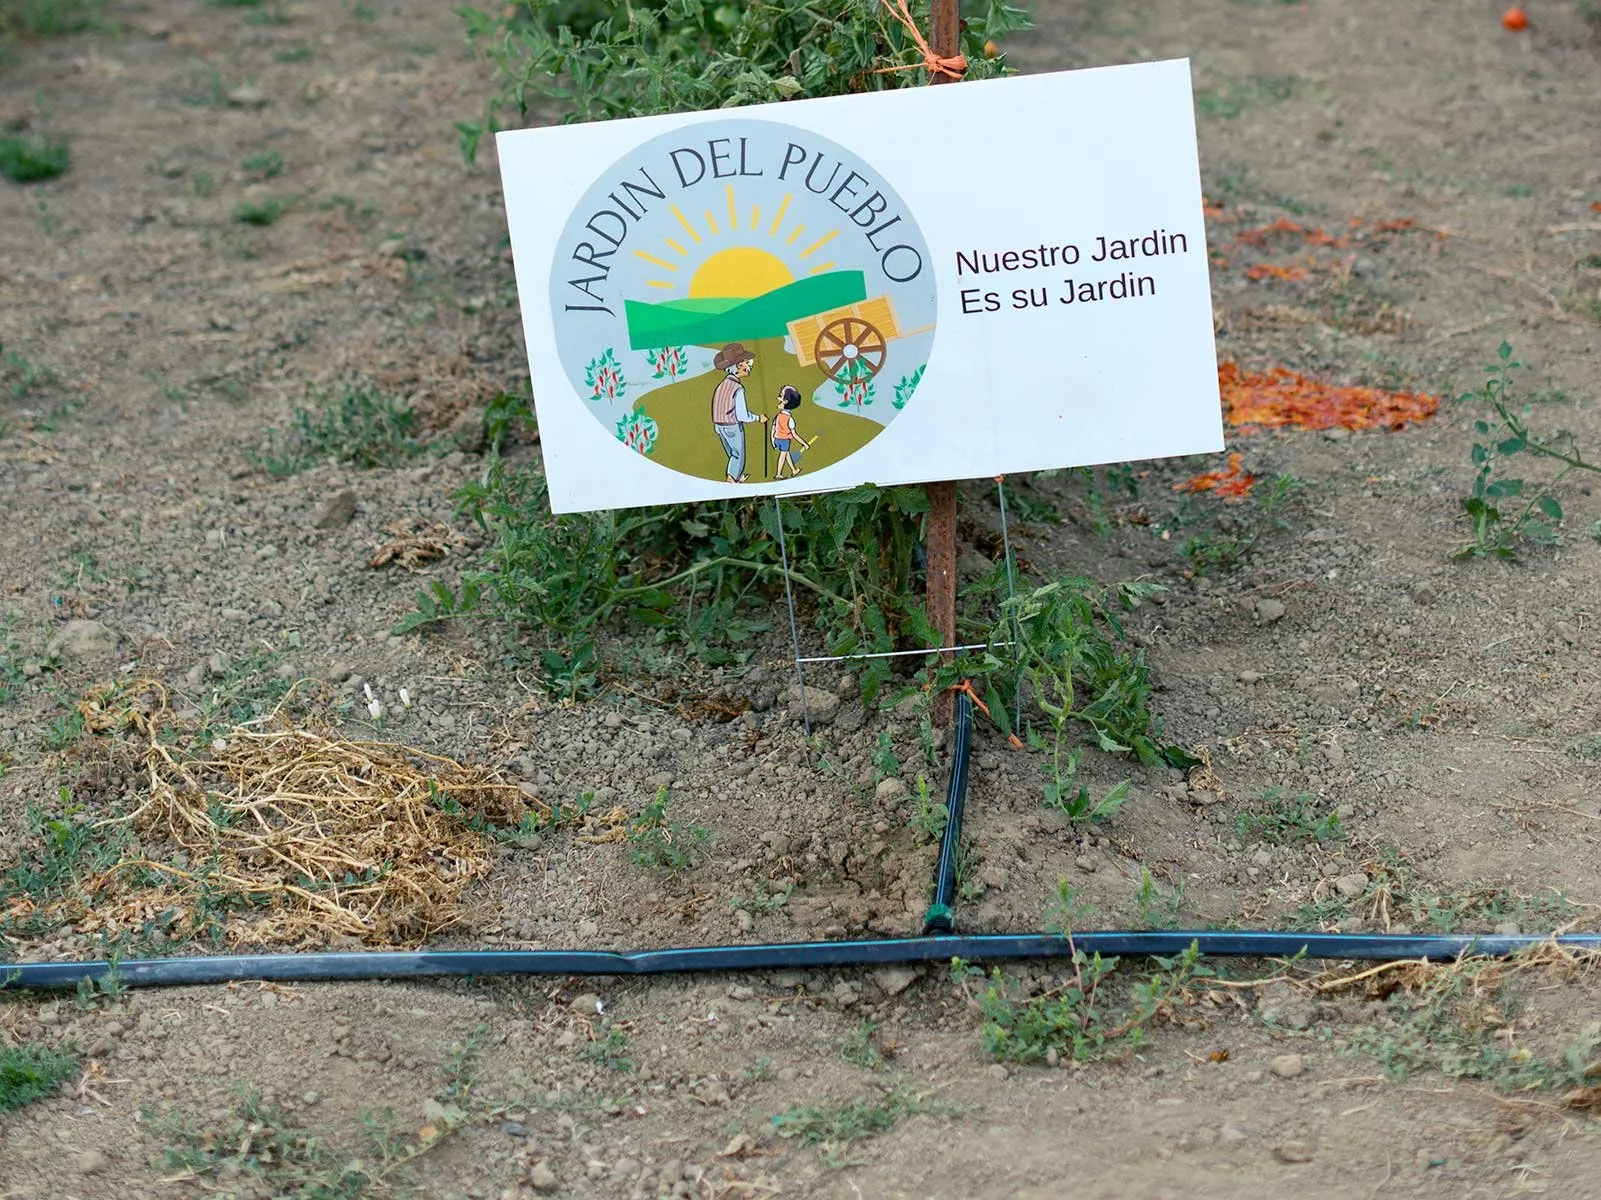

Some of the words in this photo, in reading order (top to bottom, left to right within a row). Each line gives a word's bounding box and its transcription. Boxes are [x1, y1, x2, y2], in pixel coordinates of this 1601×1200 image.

[564, 166, 667, 318] JARDIN
[668, 137, 764, 189] DEL
[777, 142, 923, 284] PUEBLO
[956, 244, 1080, 276] Nuestro
[1091, 228, 1188, 262] Jardin
[960, 288, 1001, 314] Es
[1012, 287, 1048, 309] su
[1059, 271, 1156, 305] Jardin
